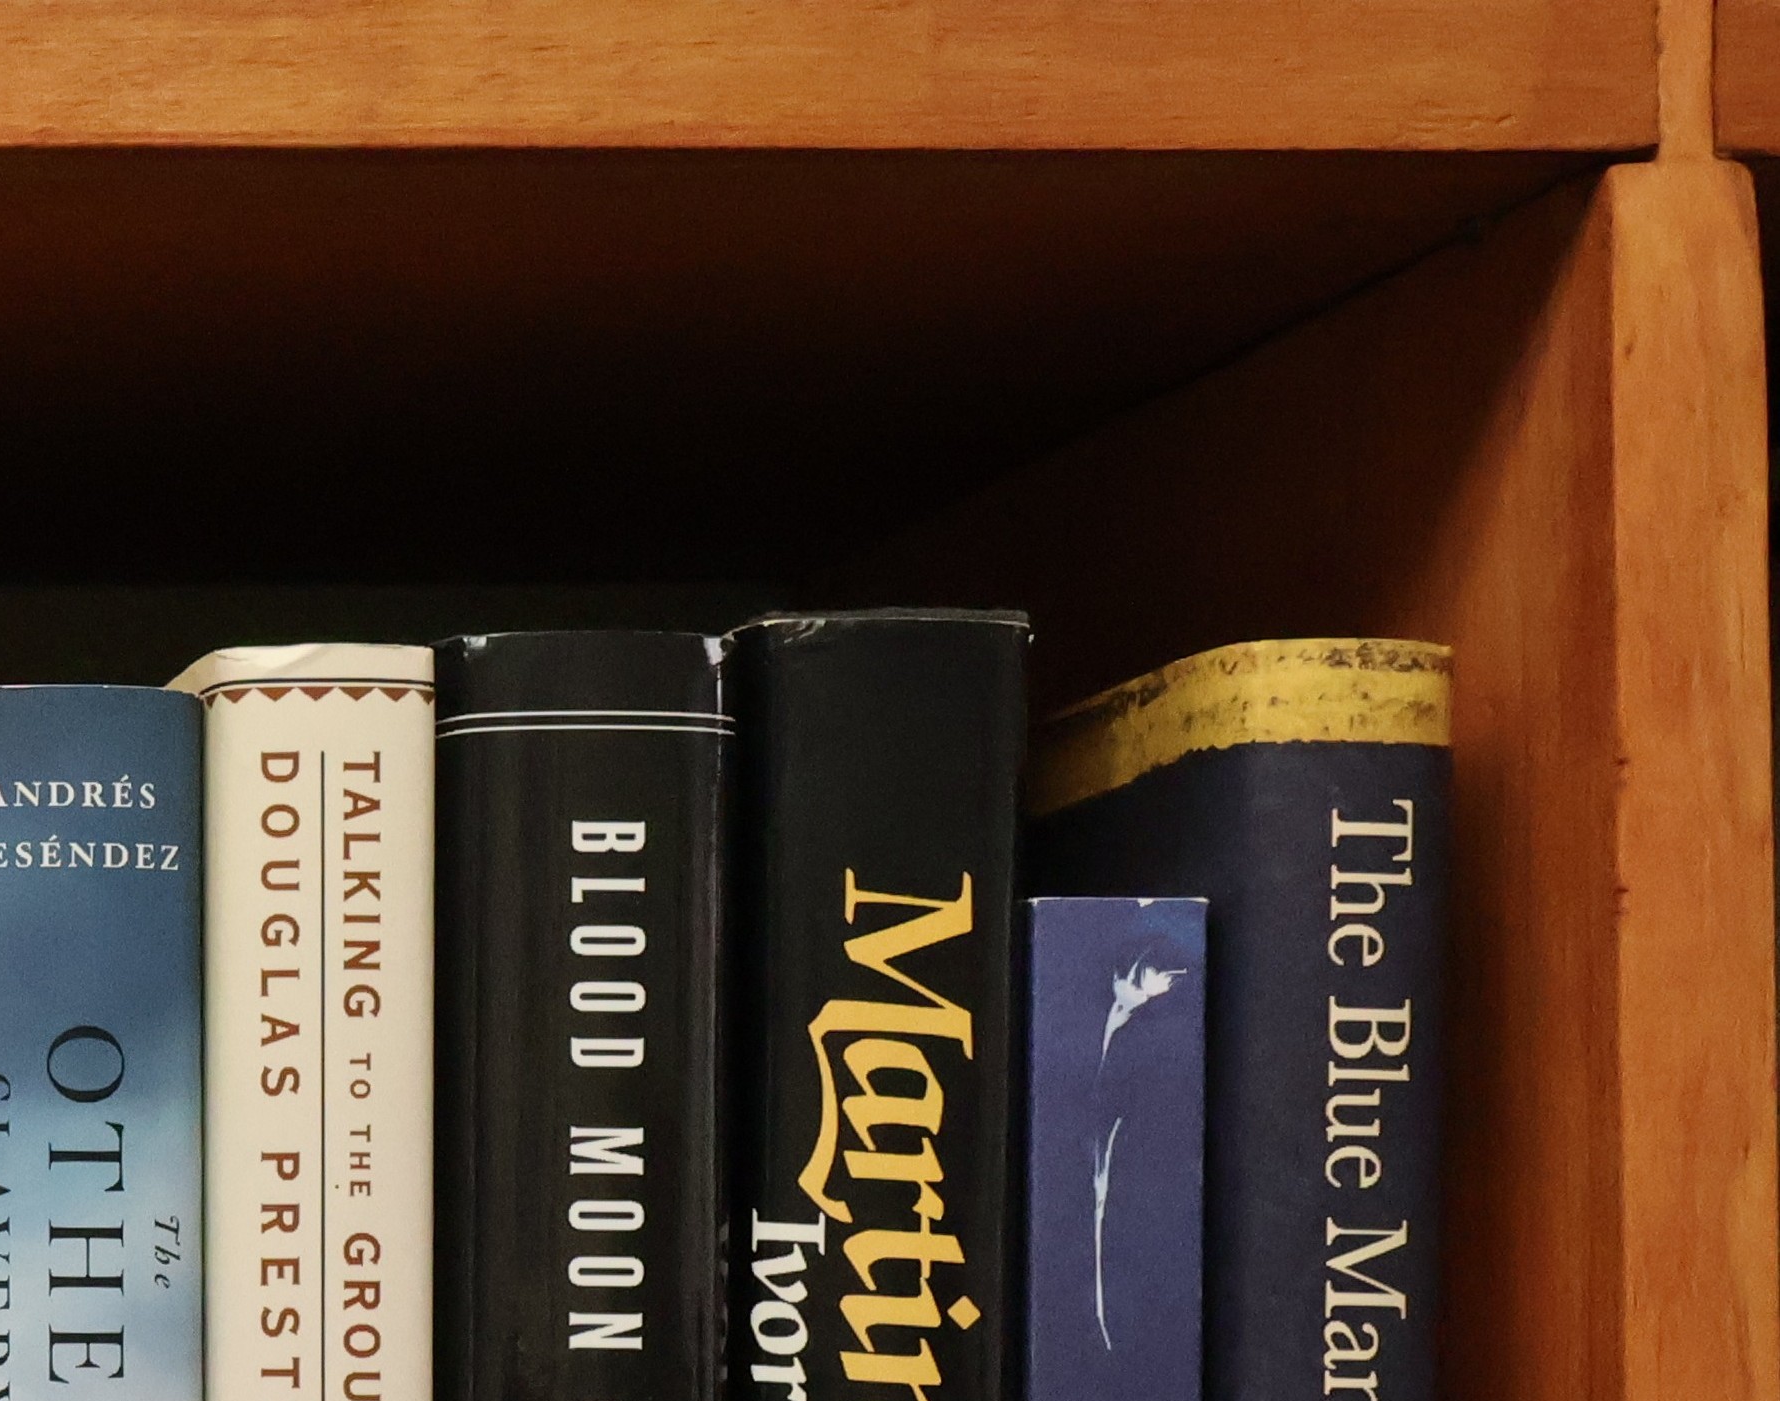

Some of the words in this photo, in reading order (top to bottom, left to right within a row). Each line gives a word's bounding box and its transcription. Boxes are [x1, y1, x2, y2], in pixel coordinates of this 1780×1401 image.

[261, 751, 300, 1096] DOUGLAS
[570, 821, 645, 1067] BLOOD
[1328, 799, 1413, 966] The
[1325, 996, 1410, 1188] Blue
[568, 1126, 644, 1349] MOON
